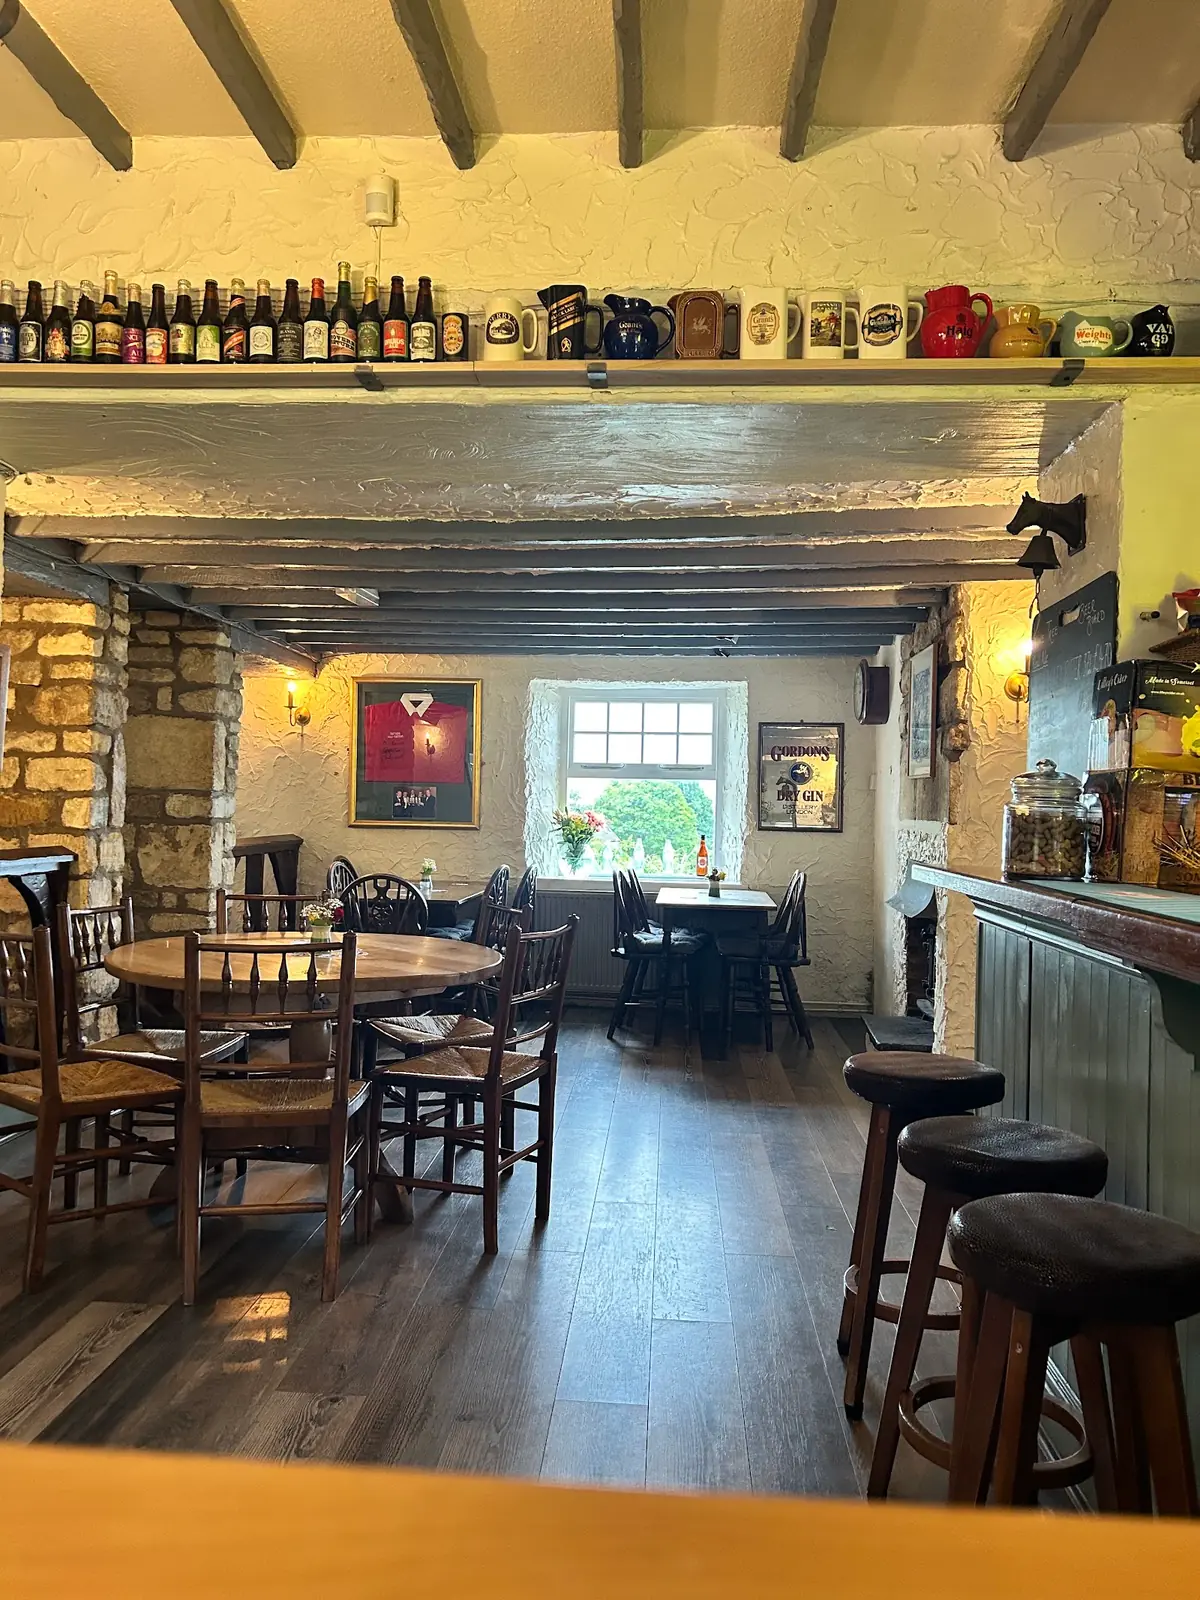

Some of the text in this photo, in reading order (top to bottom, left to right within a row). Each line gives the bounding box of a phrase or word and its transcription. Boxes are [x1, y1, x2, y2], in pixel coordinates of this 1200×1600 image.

[753, 315, 774, 324] Grant's
[946, 325, 973, 338] Haig
[1146, 323, 1173, 334] VAT
[1076, 329, 1111, 340] Weights
[1152, 334, 1168, 345] 69
[1113, 673, 1128, 686] Cider
[1145, 676, 1164, 685] Made
[1170, 677, 1195, 686] Somerset
[777, 790, 823, 801] DRY GIN
